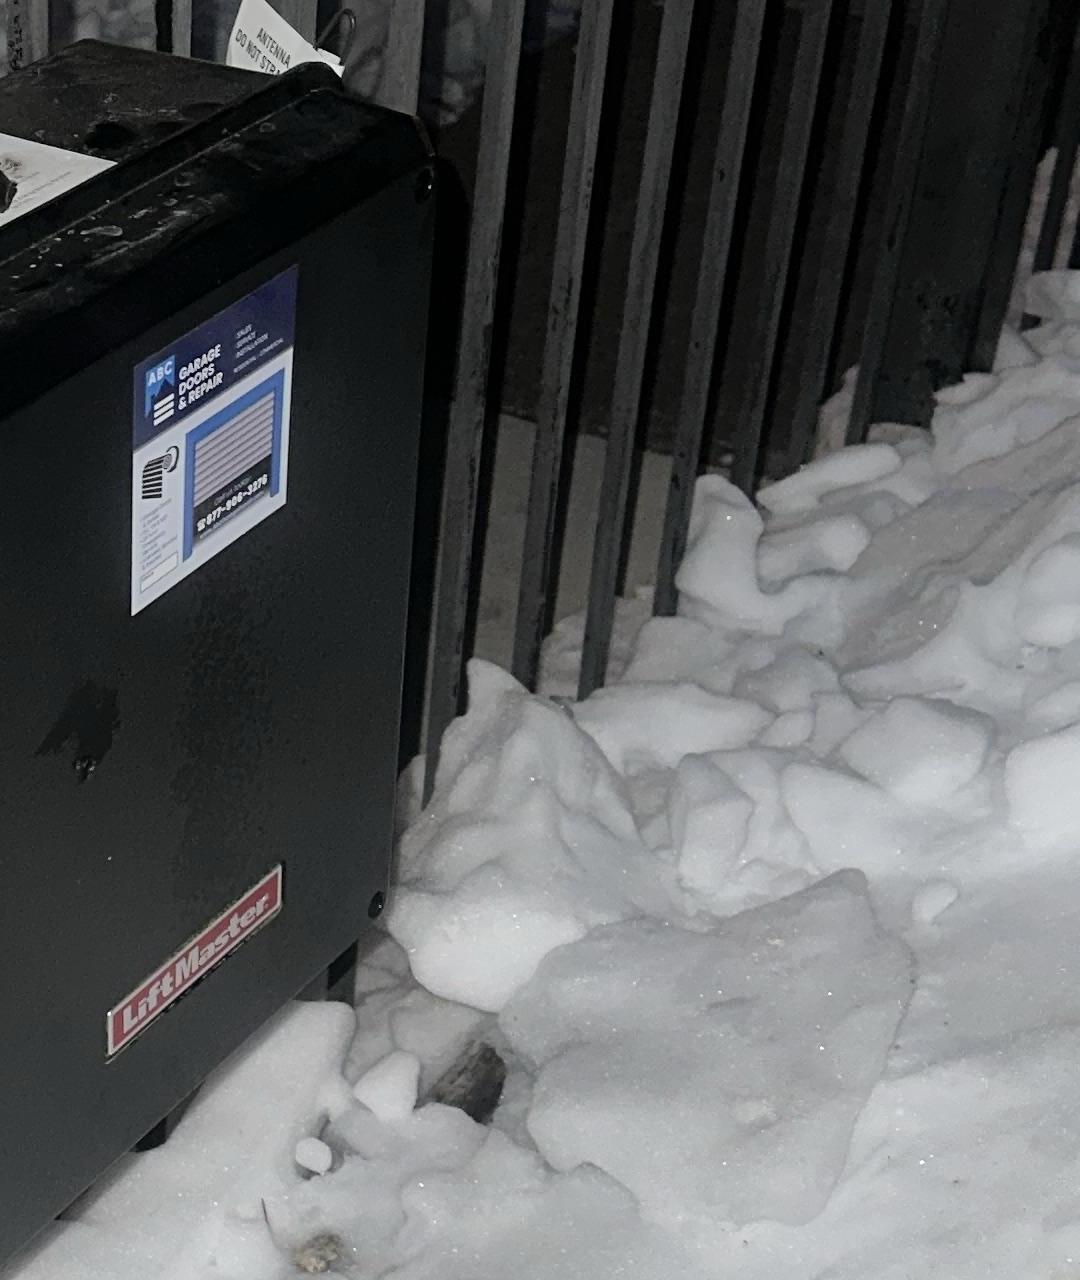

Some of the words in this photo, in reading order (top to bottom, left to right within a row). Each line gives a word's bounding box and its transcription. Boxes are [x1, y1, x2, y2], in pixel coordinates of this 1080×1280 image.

[236, 28, 247, 47] DO
[246, 40, 262, 62] NOT
[260, 55, 280, 75] STR
[257, 27, 291, 68] ANTENNA
[148, 361, 173, 387] ABC
[178, 343, 221, 380] GARAGE
[178, 363, 215, 396] DOORS
[178, 397, 187, 411] &
[188, 372, 224, 404] REPAIR
[122, 893, 270, 1035] LiftMaster
